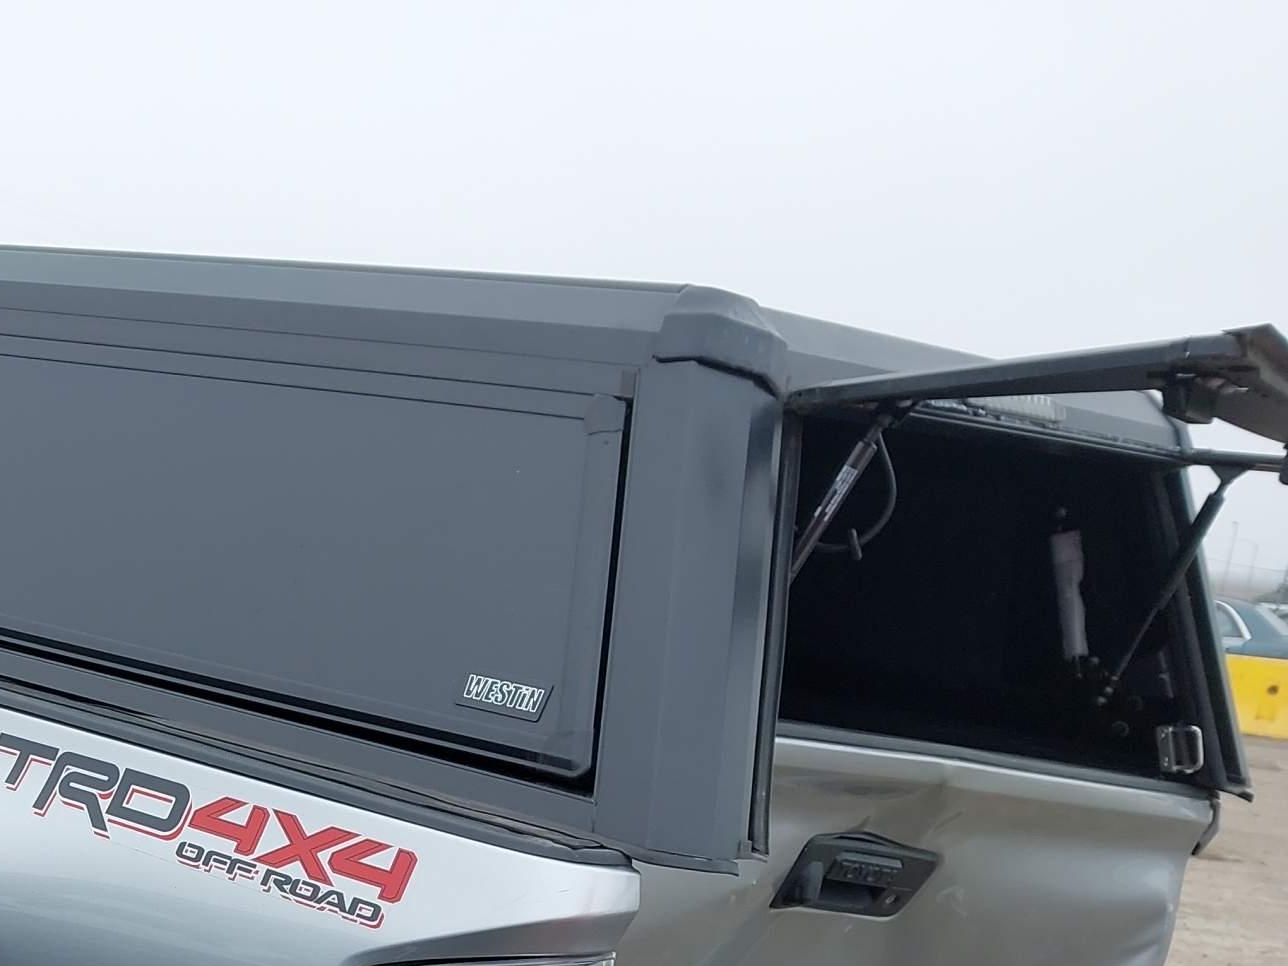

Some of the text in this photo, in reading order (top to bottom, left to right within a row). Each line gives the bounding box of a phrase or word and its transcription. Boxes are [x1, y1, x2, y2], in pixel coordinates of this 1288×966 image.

[175, 840, 385, 930] OFF ROAD
[188, 795, 418, 904] 4X4
